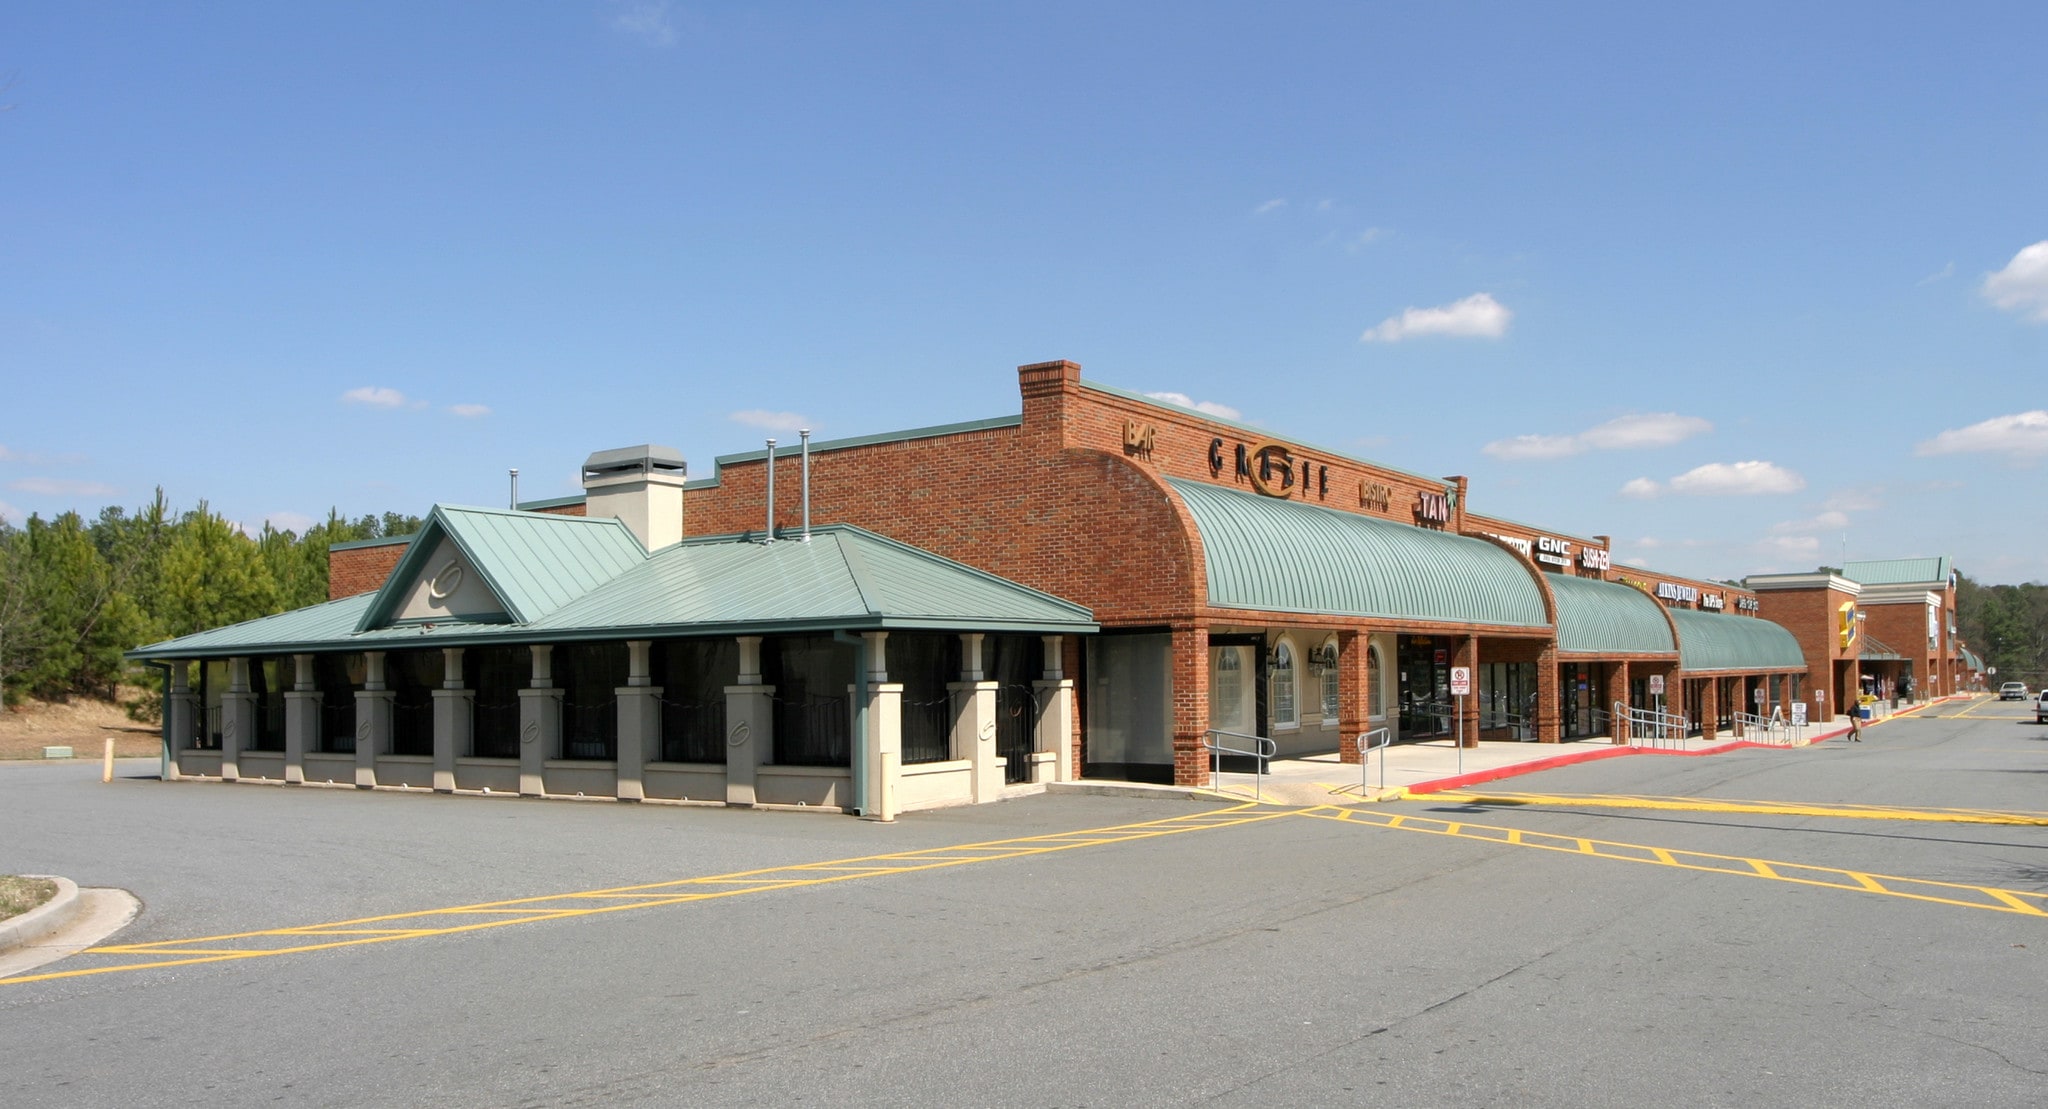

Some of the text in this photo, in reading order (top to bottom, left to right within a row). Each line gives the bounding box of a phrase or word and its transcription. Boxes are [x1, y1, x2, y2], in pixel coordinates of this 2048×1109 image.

[1124, 419, 1156, 450] BAR
[1361, 479, 1393, 503] BISTRO
[1420, 491, 1449, 522] TAN
[1537, 536, 1571, 555] GNC
